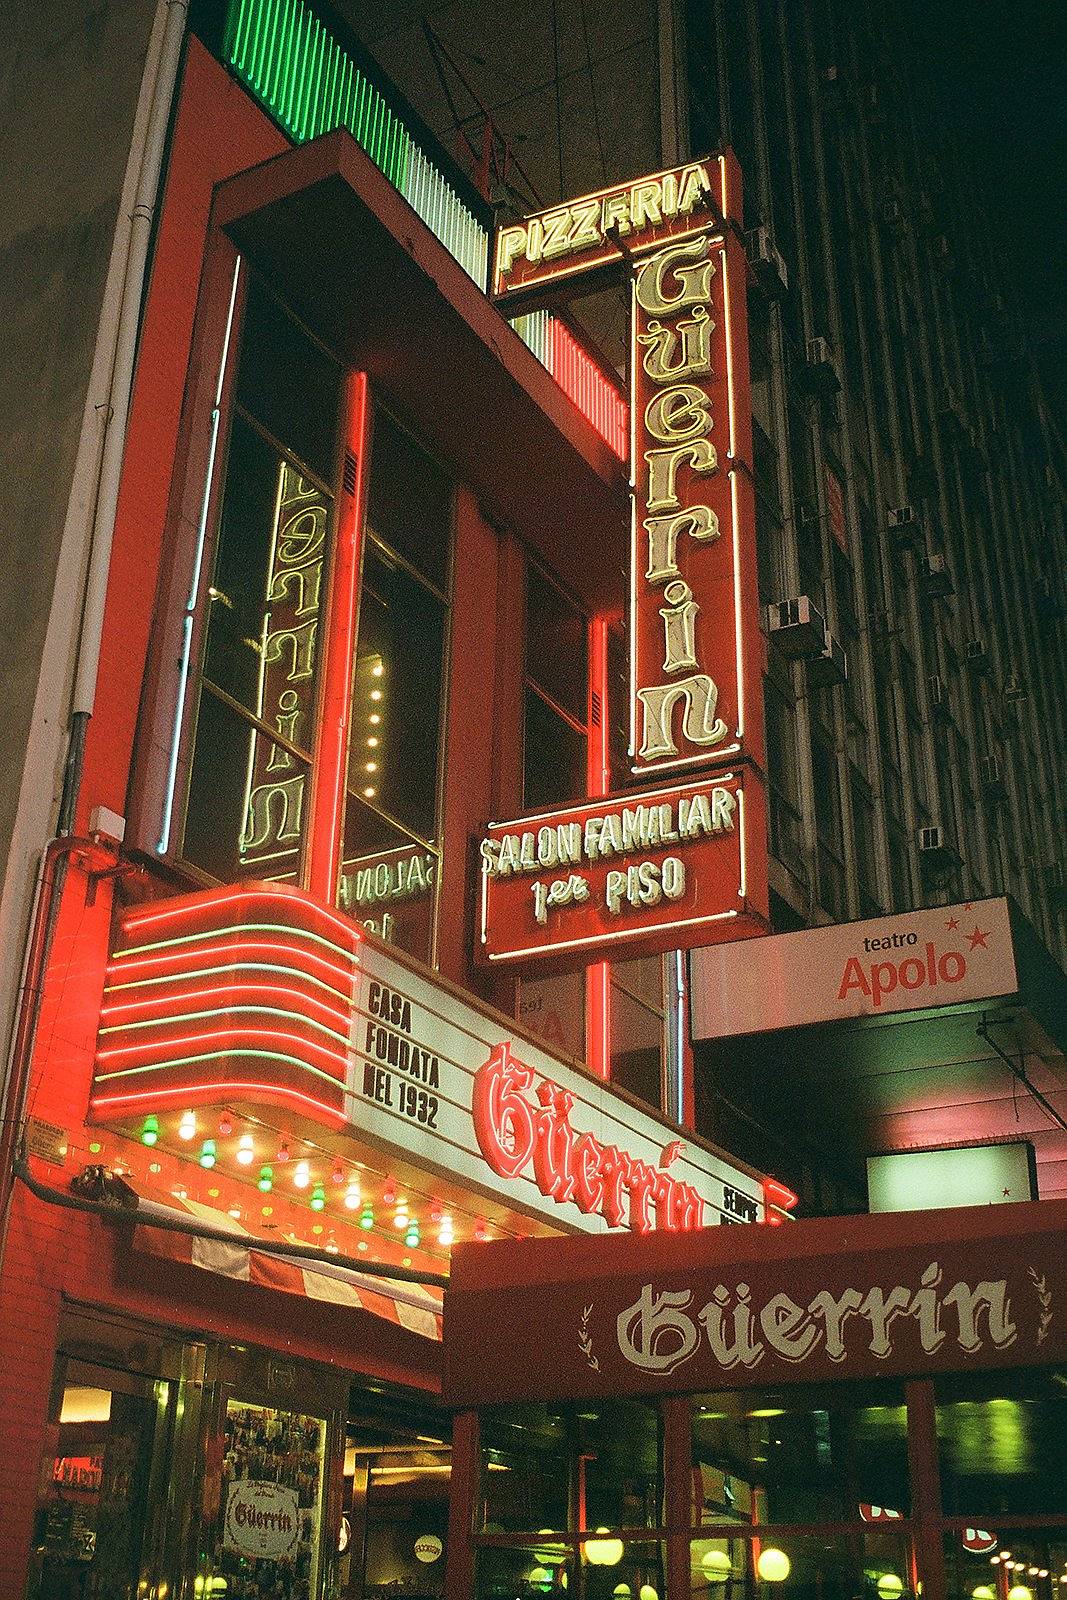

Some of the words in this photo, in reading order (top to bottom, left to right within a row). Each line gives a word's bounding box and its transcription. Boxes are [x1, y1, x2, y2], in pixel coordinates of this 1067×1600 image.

[498, 164, 711, 274] PIZZERIA
[635, 235, 728, 760] Güerrin
[480, 822, 582, 877] SALON
[584, 787, 737, 859] FAMILIAR
[531, 874, 590, 926] 1er
[606, 856, 686, 915] PISO
[837, 942, 967, 1007] Apolo
[863, 931, 918, 953] teatro
[368, 981, 412, 1034] CASA
[365, 1021, 440, 1089] FONDATA
[363, 1062, 394, 1107] NEL
[399, 1082, 439, 1130] 1932
[616, 1261, 1018, 1377] Güerrin
